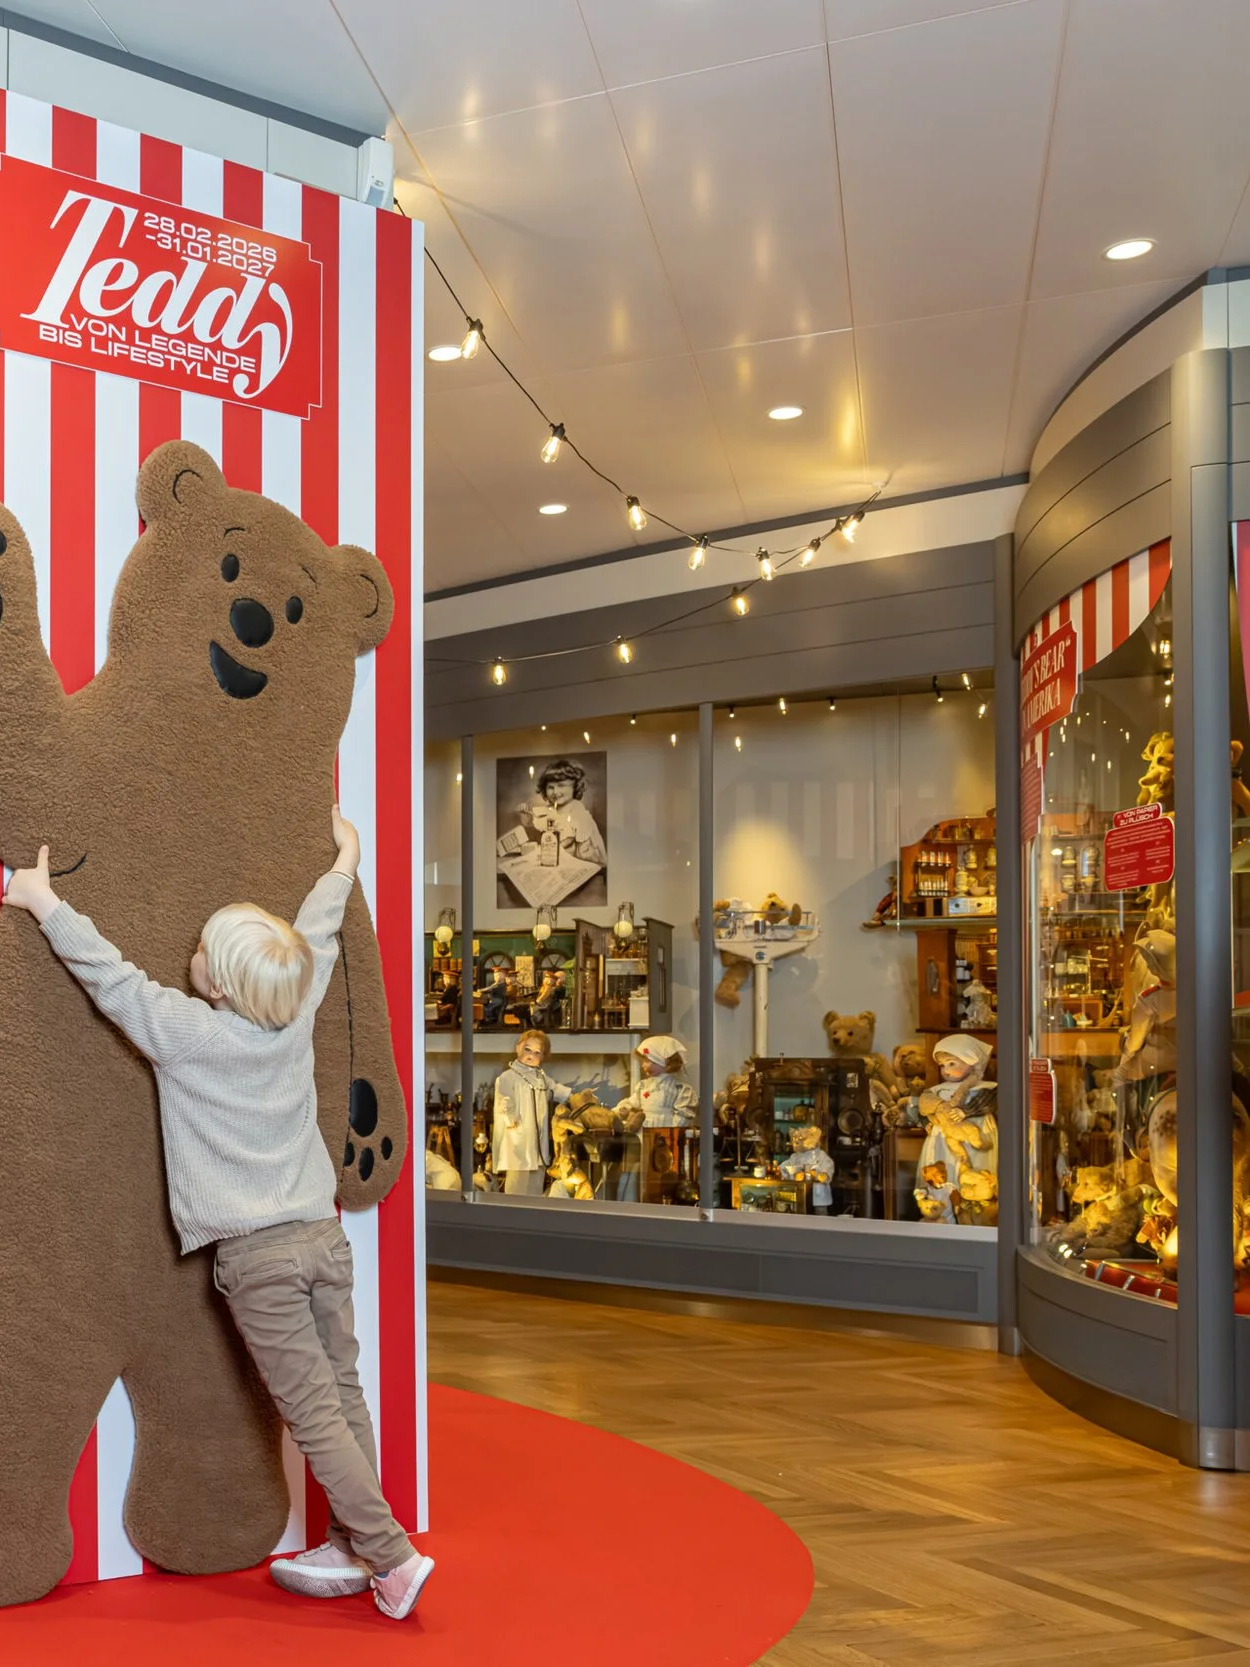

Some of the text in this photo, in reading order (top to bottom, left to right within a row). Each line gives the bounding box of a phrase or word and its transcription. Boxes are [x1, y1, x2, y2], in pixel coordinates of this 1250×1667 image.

[144, 212, 277, 262] 28.02.2026
[145, 232, 275, 277] -31.01.2027
[20, 190, 293, 399] Teddy
[39, 324, 229, 384] BIS LIFESTYLE
[70, 313, 256, 373] VON LEGENDE
